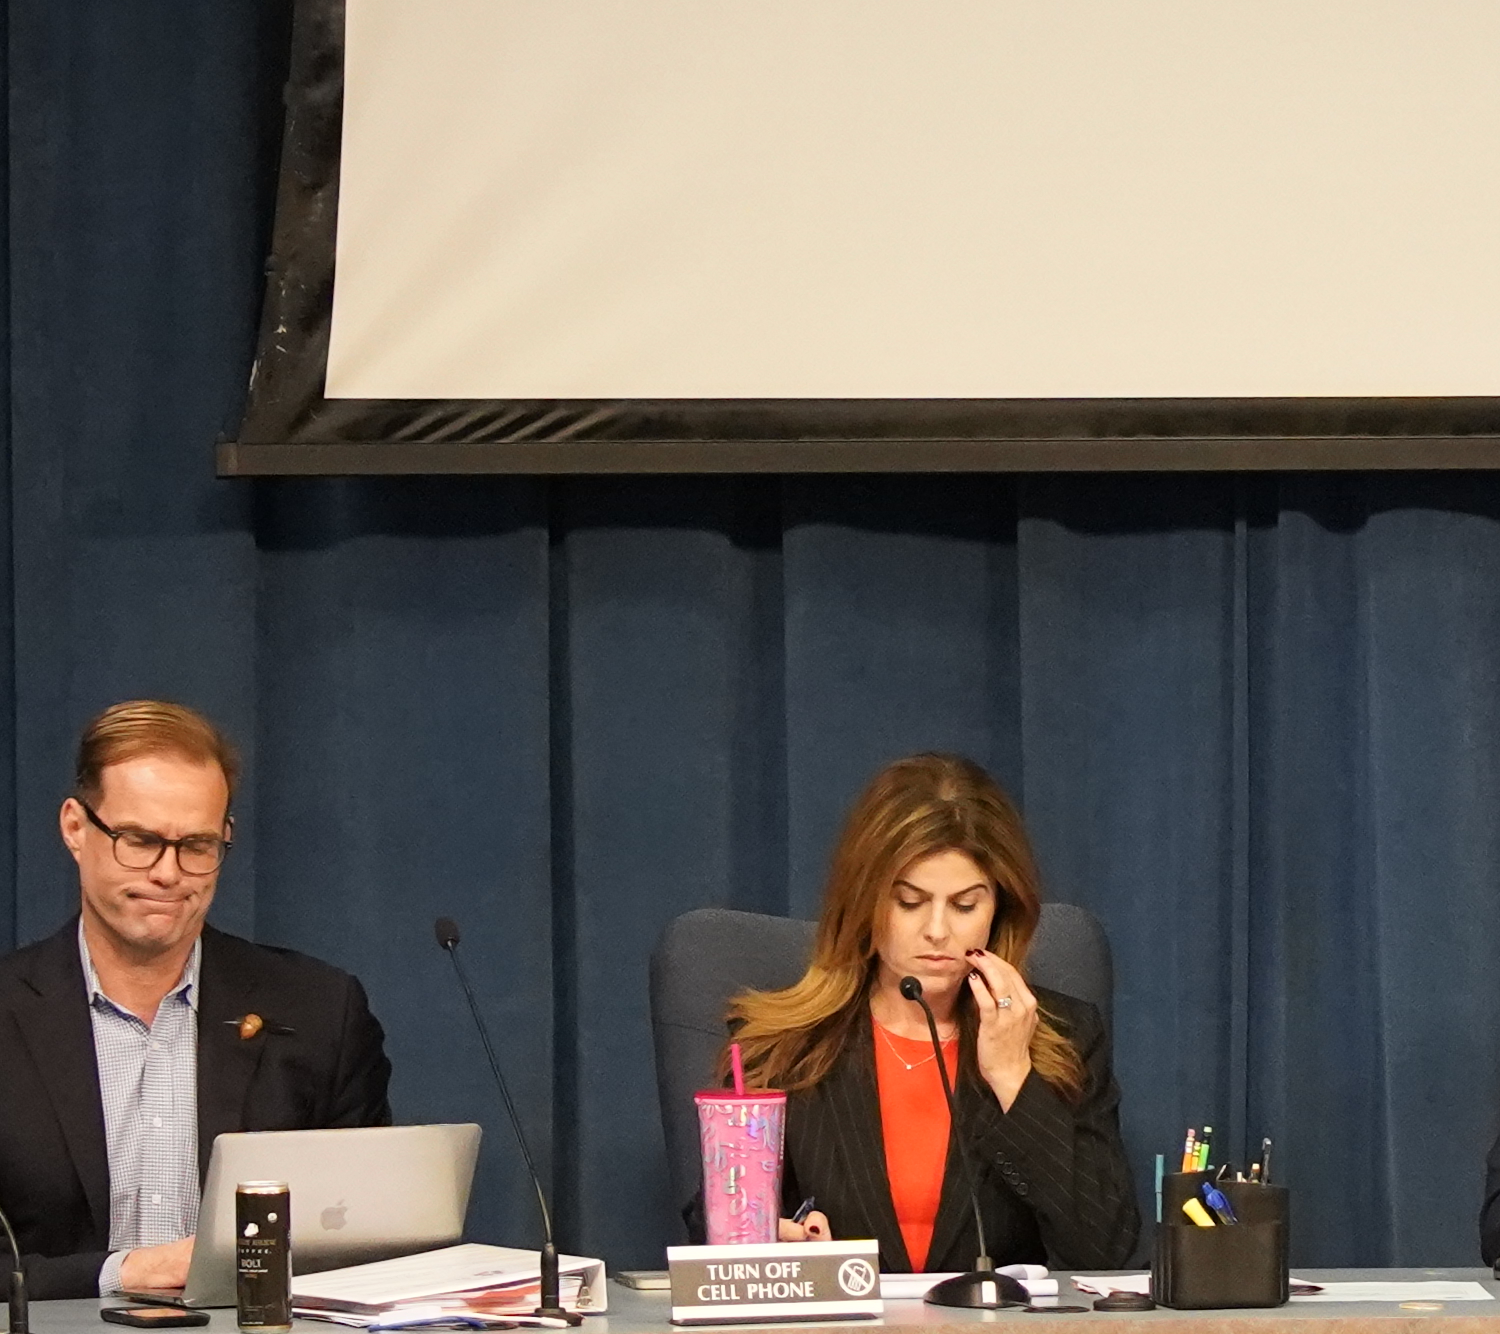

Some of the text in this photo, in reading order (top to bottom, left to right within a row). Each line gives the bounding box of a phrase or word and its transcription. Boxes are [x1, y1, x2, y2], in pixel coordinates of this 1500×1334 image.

[706, 1262, 802, 1281] TURN OFF
[697, 1281, 815, 1301] CELL PHONE
